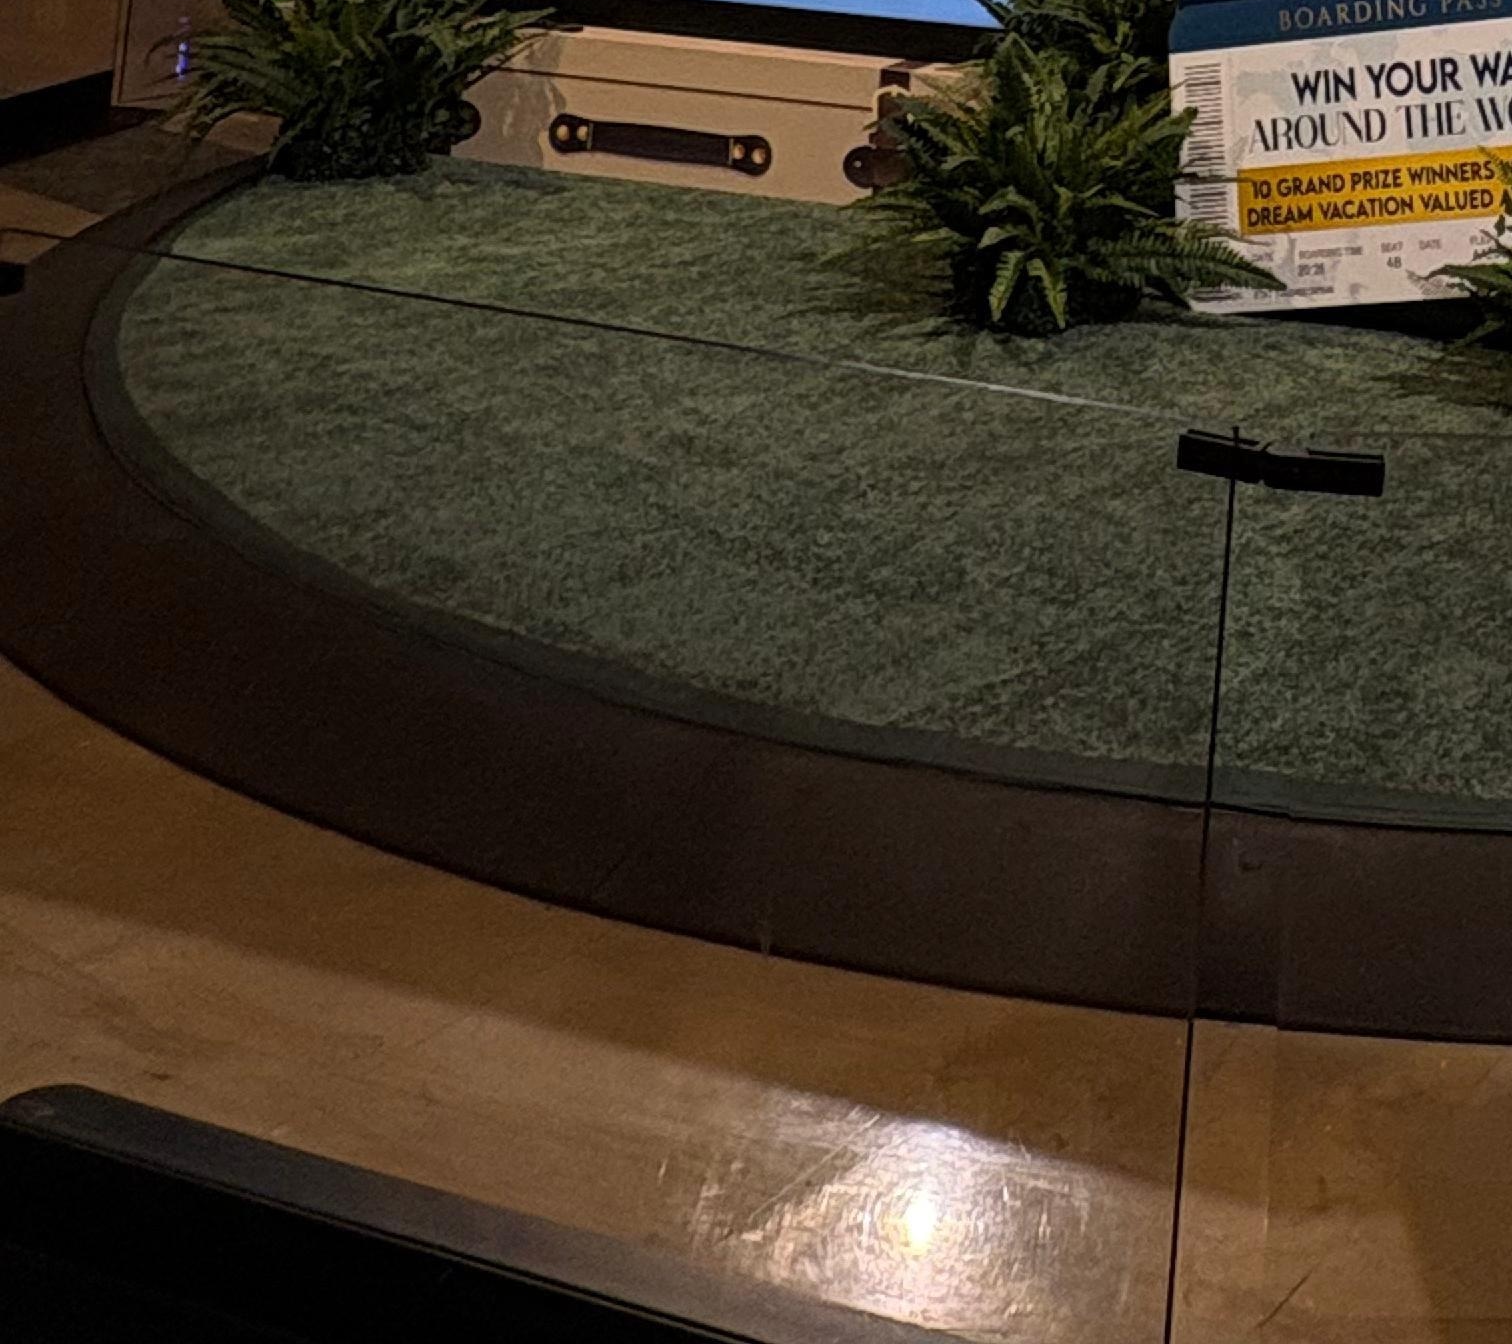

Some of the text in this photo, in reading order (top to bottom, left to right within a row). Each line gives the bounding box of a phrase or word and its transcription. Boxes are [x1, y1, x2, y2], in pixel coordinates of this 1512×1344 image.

[1291, 67, 1357, 107] WIN
[1366, 57, 1463, 99] YOUR
[1250, 109, 1387, 153] AROUND
[1397, 99, 1466, 139] THE
[1252, 180, 1271, 200] 10
[1276, 174, 1344, 196] GRAND
[1350, 167, 1402, 191] PRIZE
[1406, 160, 1495, 186] WINNERS
[1247, 204, 1314, 227] DREAM
[1317, 195, 1414, 221] VACATION
[1418, 189, 1494, 212] VALUED
